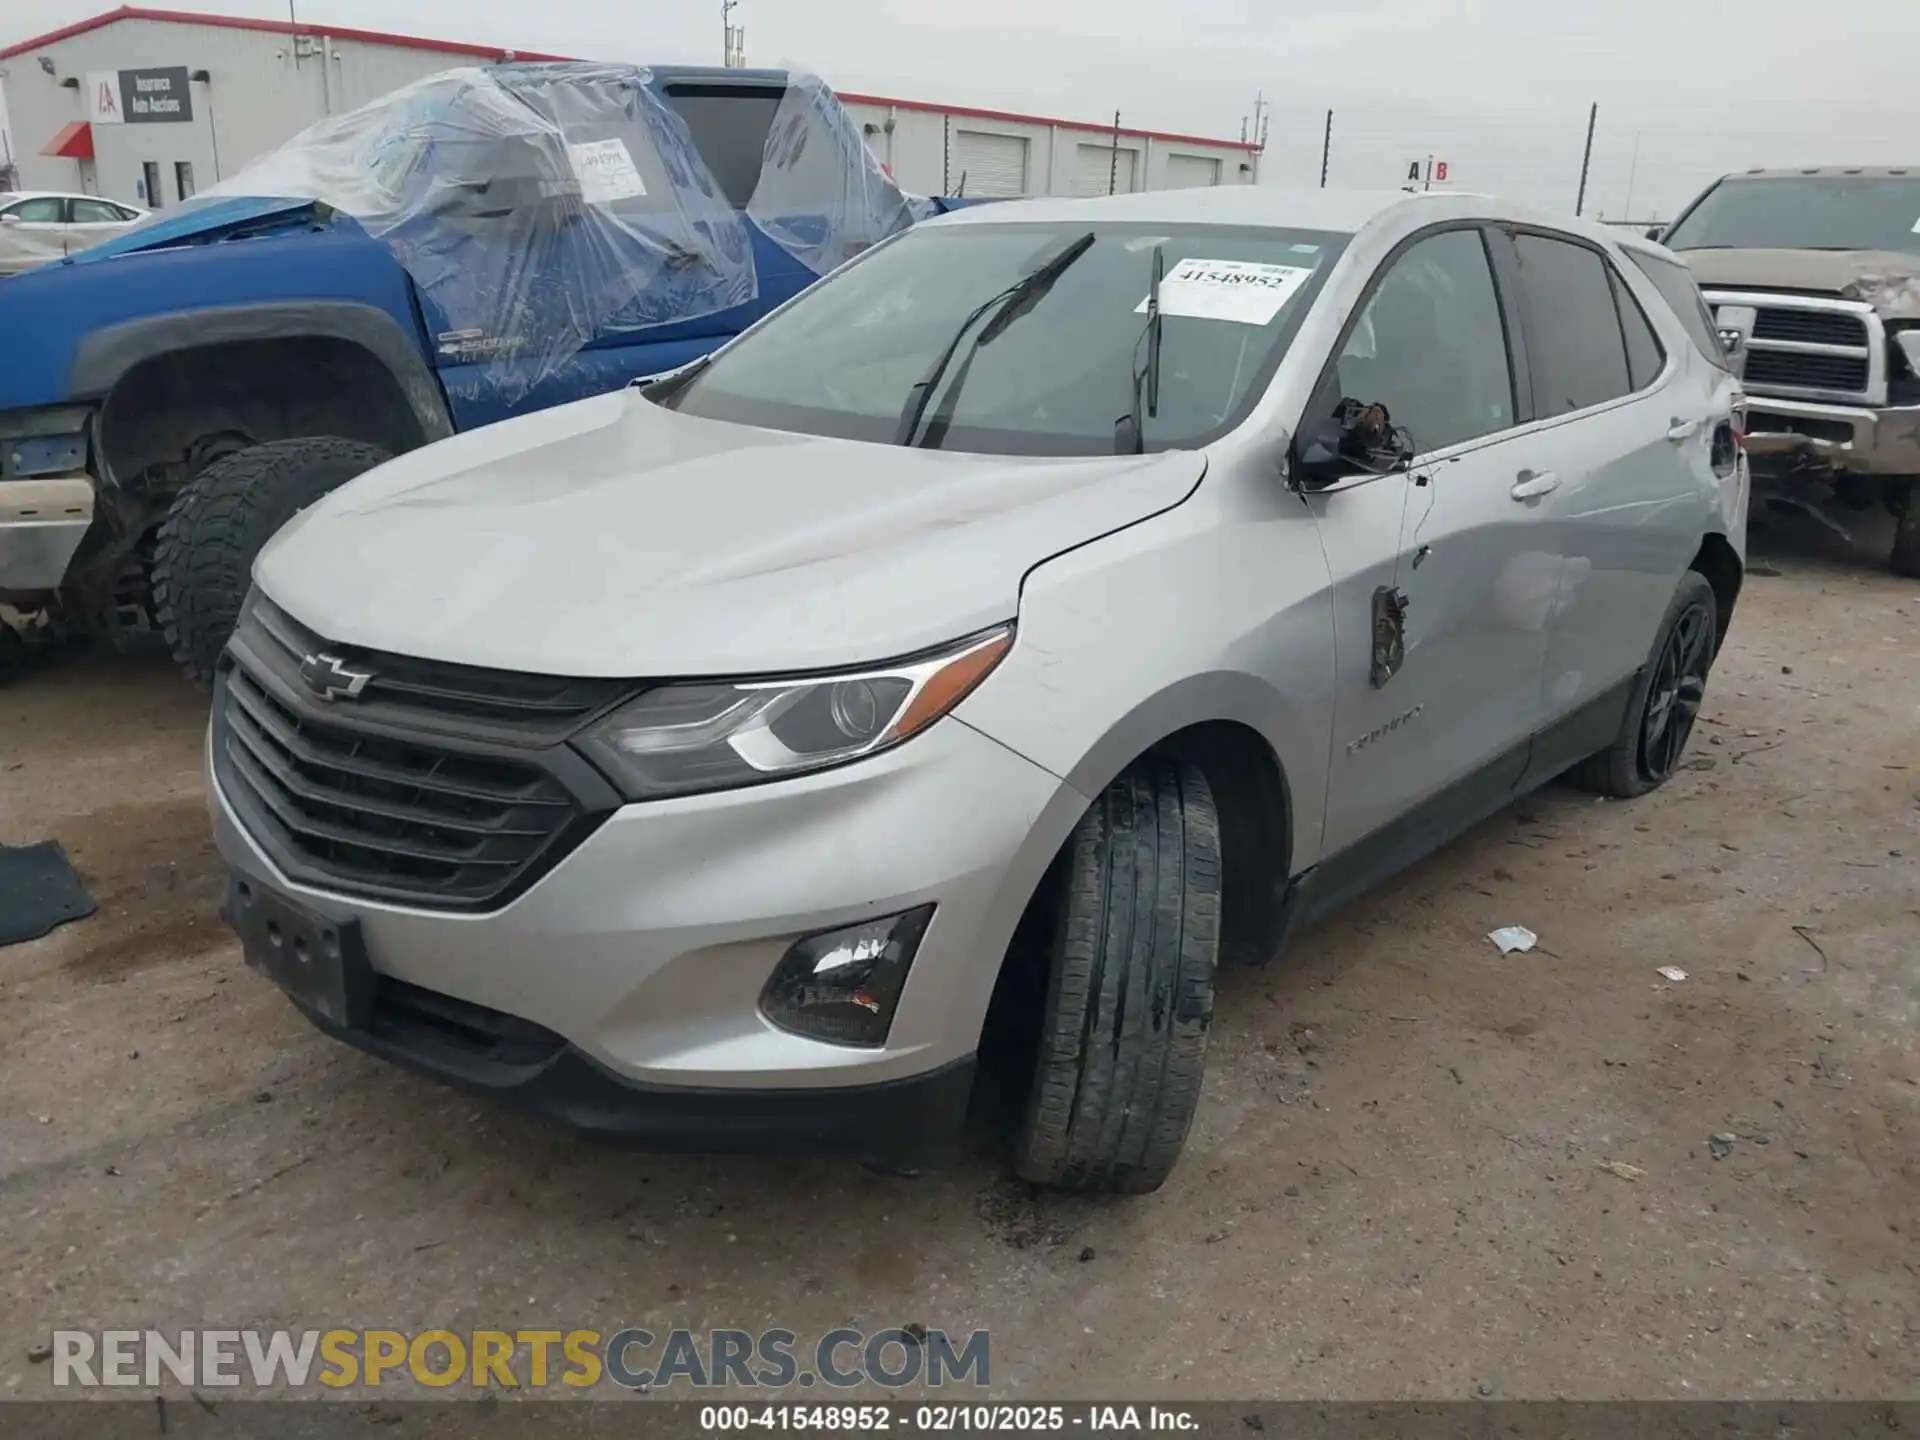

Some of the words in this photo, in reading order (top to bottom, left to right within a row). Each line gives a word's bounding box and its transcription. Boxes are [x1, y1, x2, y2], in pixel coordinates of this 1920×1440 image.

[1408, 161, 1420, 180] A
[1436, 161, 1448, 180] B
[1179, 269, 1284, 289] 41548952
